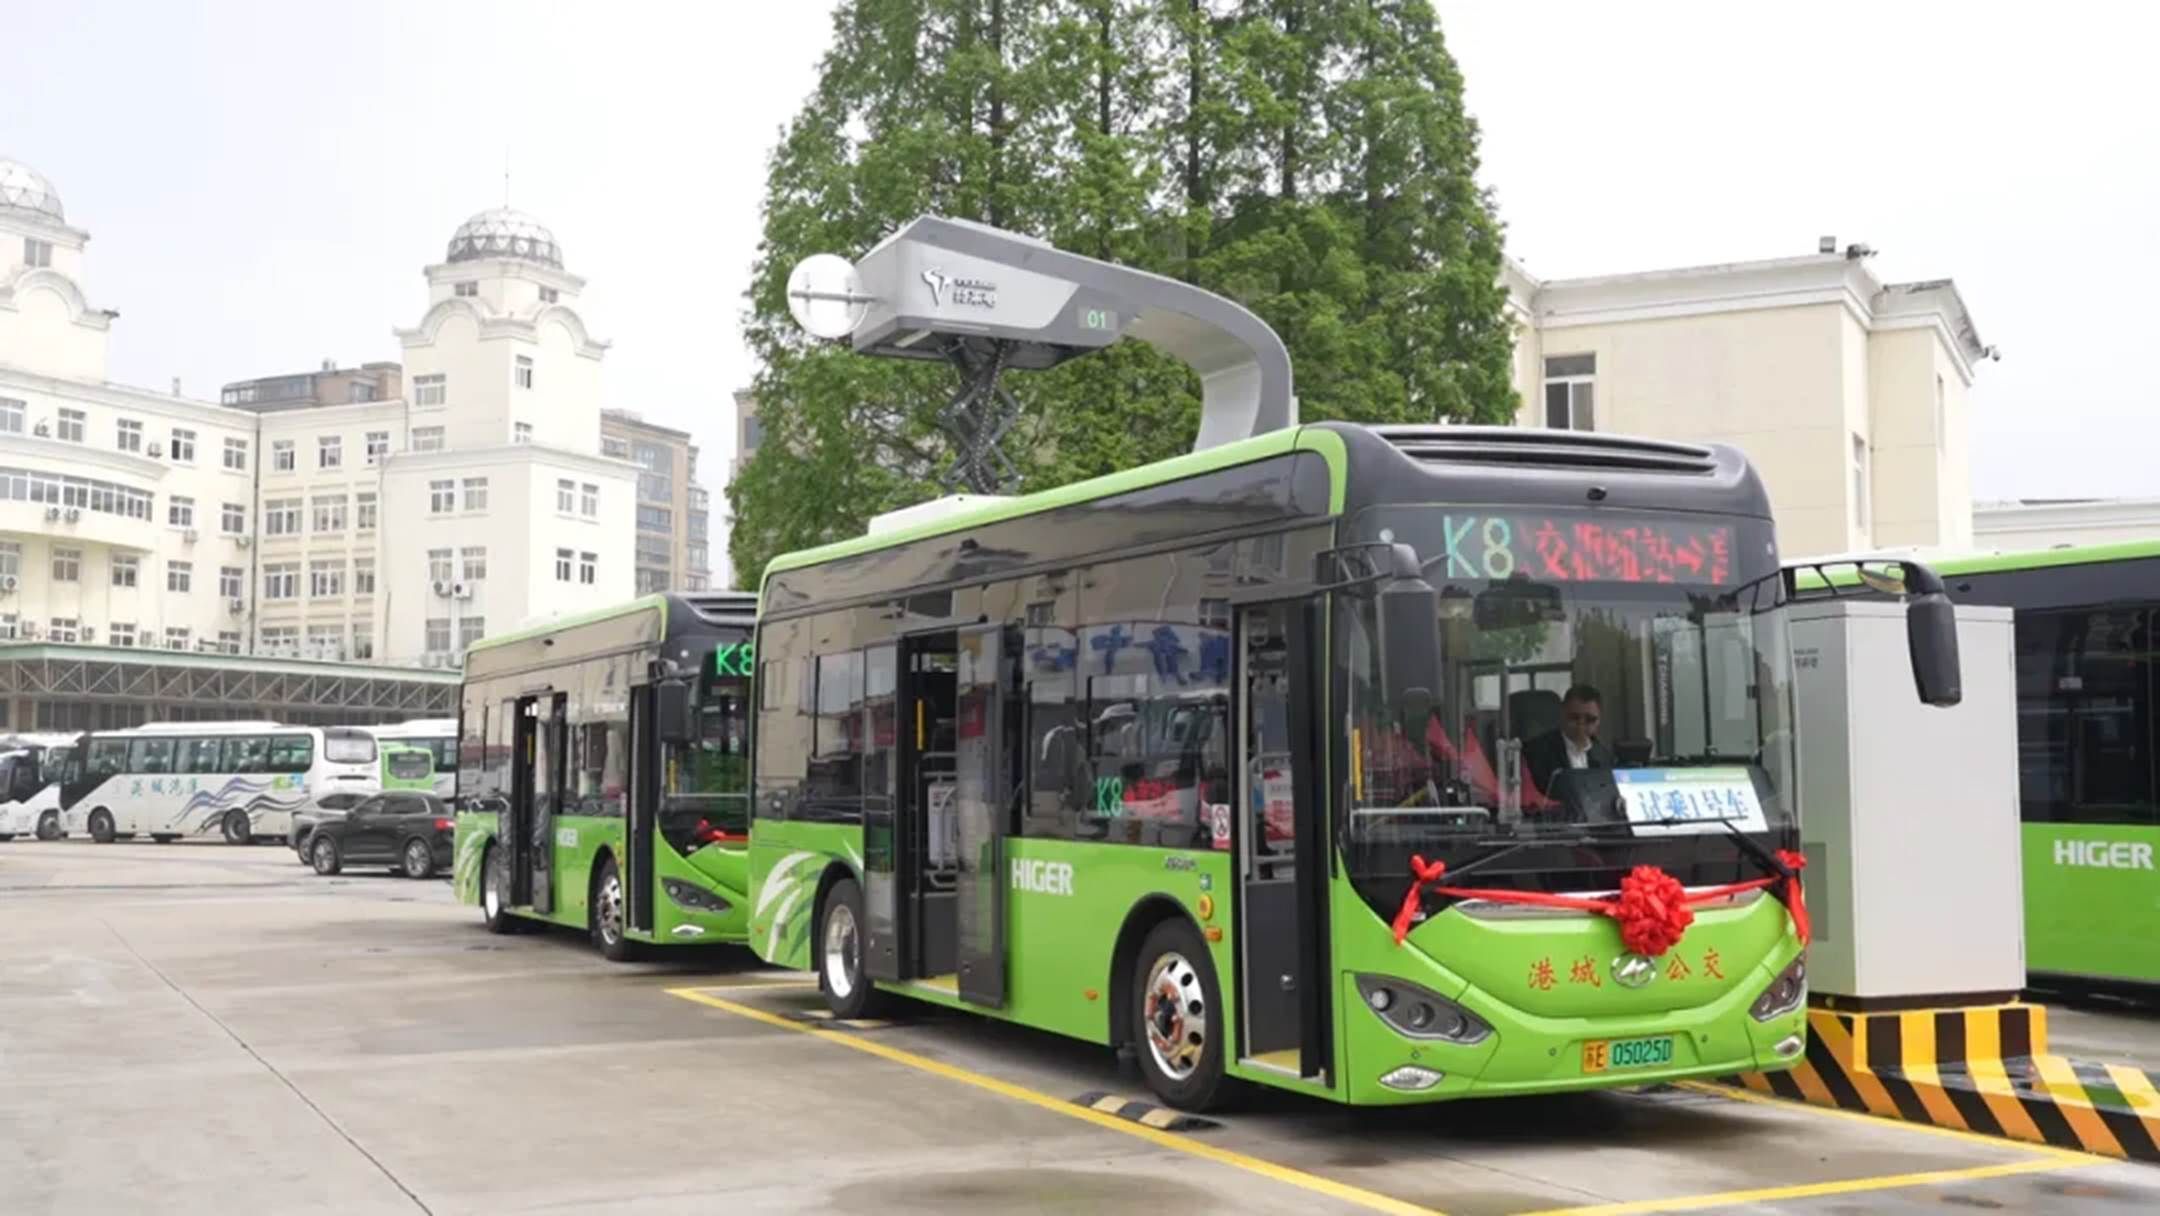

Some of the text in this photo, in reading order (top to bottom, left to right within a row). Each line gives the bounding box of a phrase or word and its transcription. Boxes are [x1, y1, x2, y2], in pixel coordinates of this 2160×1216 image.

[1087, 309, 1107, 329] 01
[1443, 515, 1514, 579] K8
[716, 642, 753, 676] K8
[1097, 776, 1122, 817] K8
[2053, 839, 2155, 871] HIGER
[1011, 857, 1073, 896] HIGER
[1528, 947, 1725, 991] 港城 公交
[1612, 1038, 1672, 1066] 05025D
